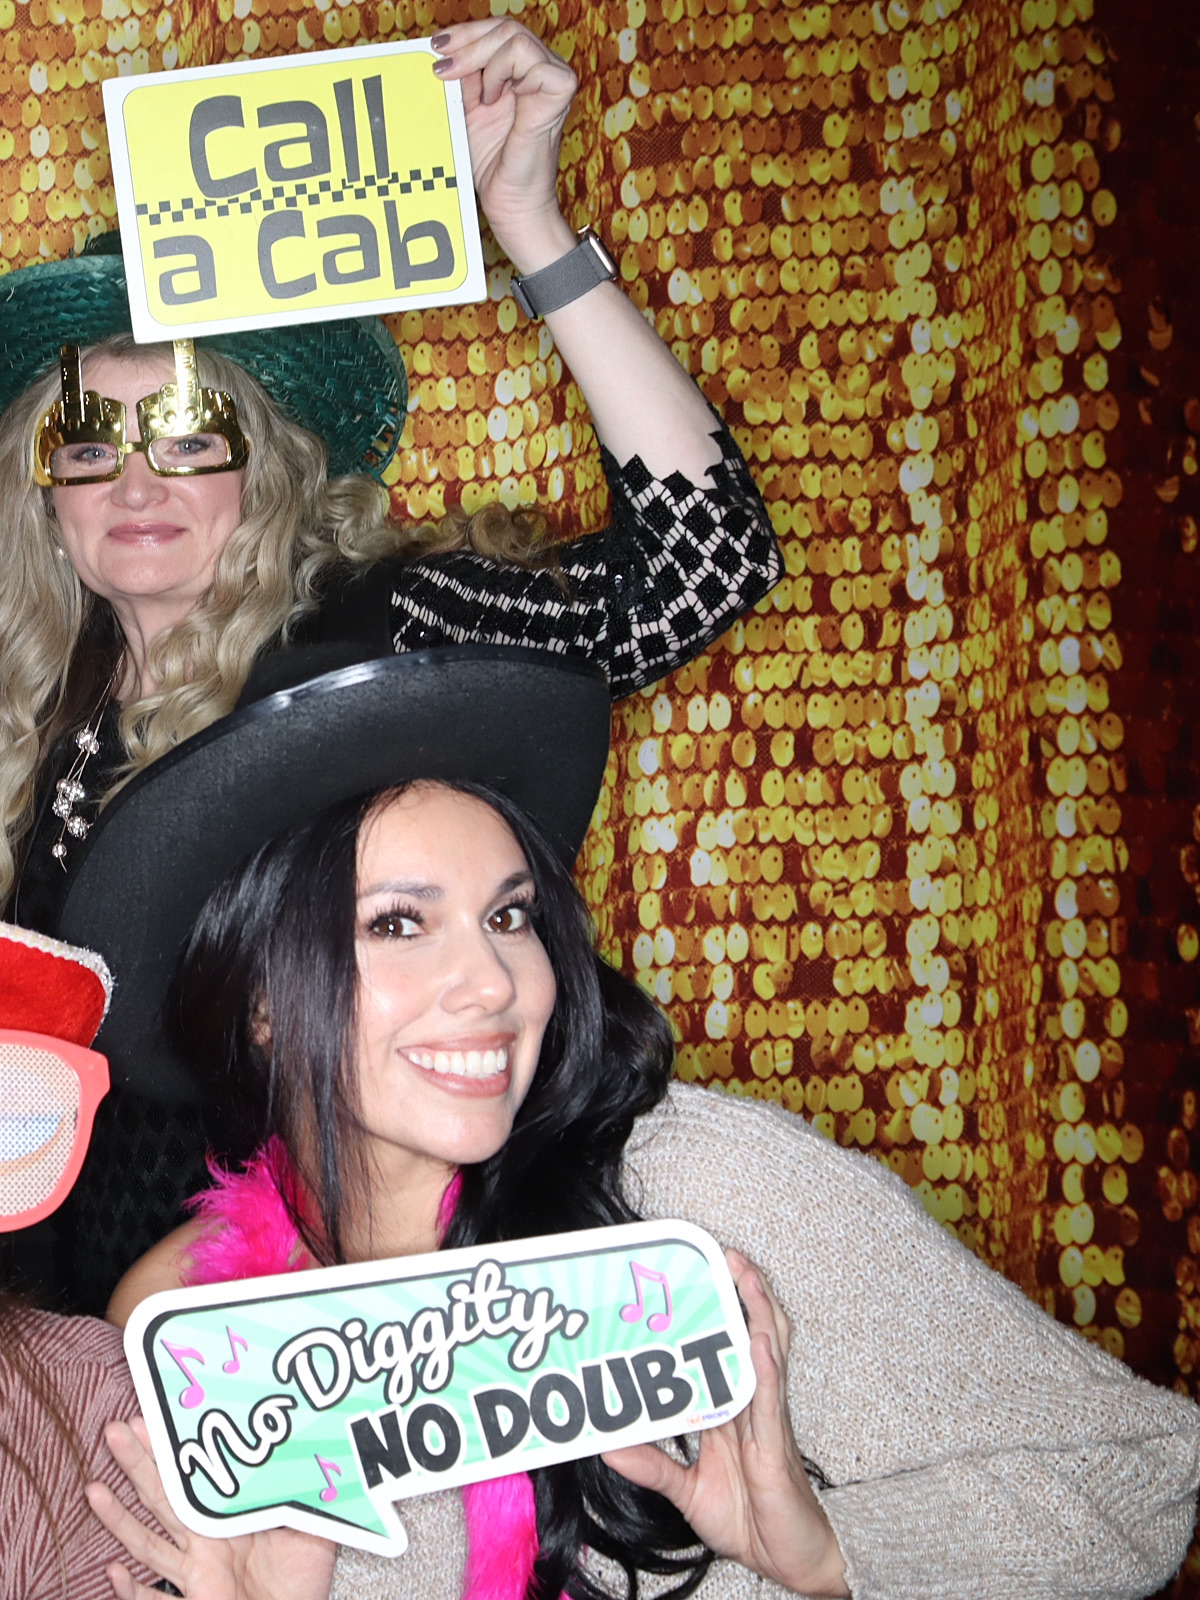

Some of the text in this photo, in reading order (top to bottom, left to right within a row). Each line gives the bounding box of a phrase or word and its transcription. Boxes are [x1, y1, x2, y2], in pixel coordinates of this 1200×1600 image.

[188, 73, 391, 199] Call
[152, 199, 456, 306] a Cab
[176, 1259, 590, 1499] No Diggity,
[349, 1329, 735, 1490] NO DOUBT
[701, 1409, 731, 1422] PROPS
